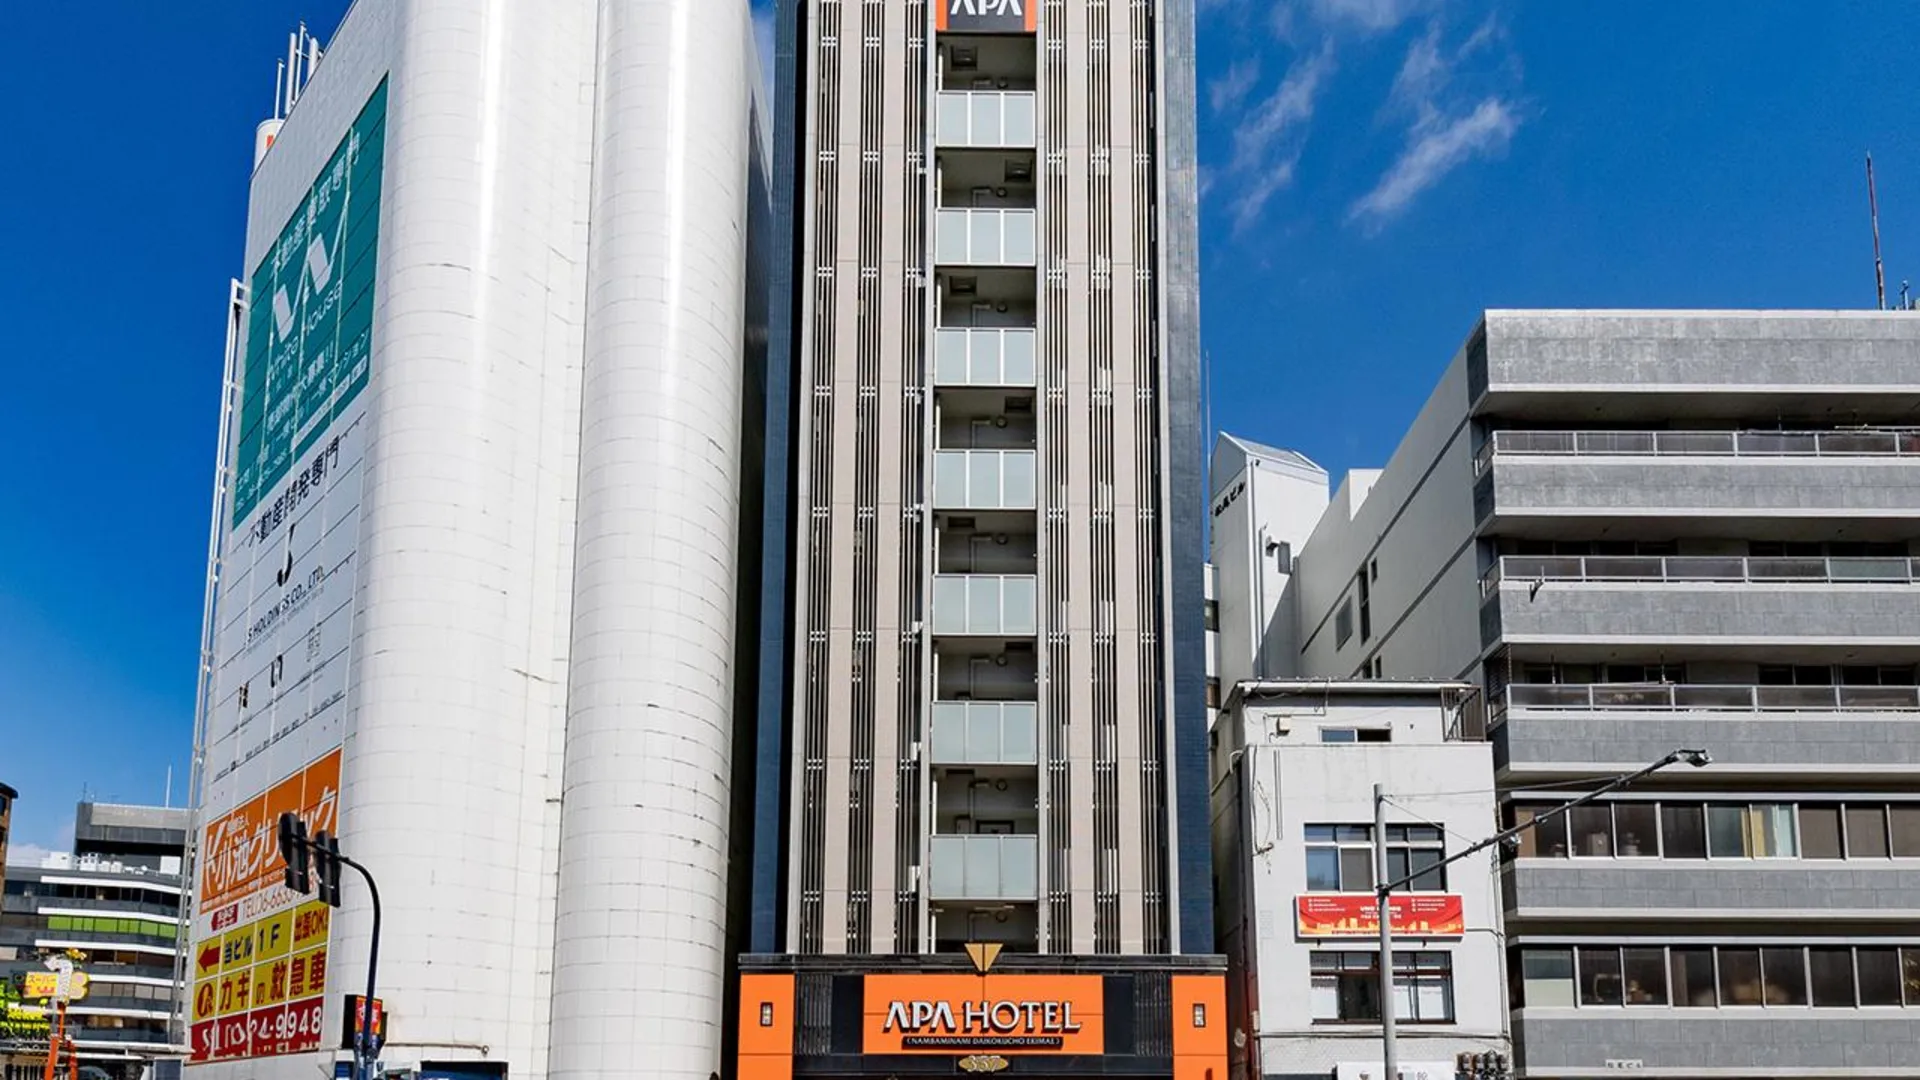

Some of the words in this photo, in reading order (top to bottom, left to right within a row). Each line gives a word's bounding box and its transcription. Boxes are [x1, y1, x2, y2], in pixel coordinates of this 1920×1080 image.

[248, 434, 340, 548] 不動産開発専門
[884, 1001, 957, 1030] APA
[963, 1001, 1081, 1031] HOTEL
